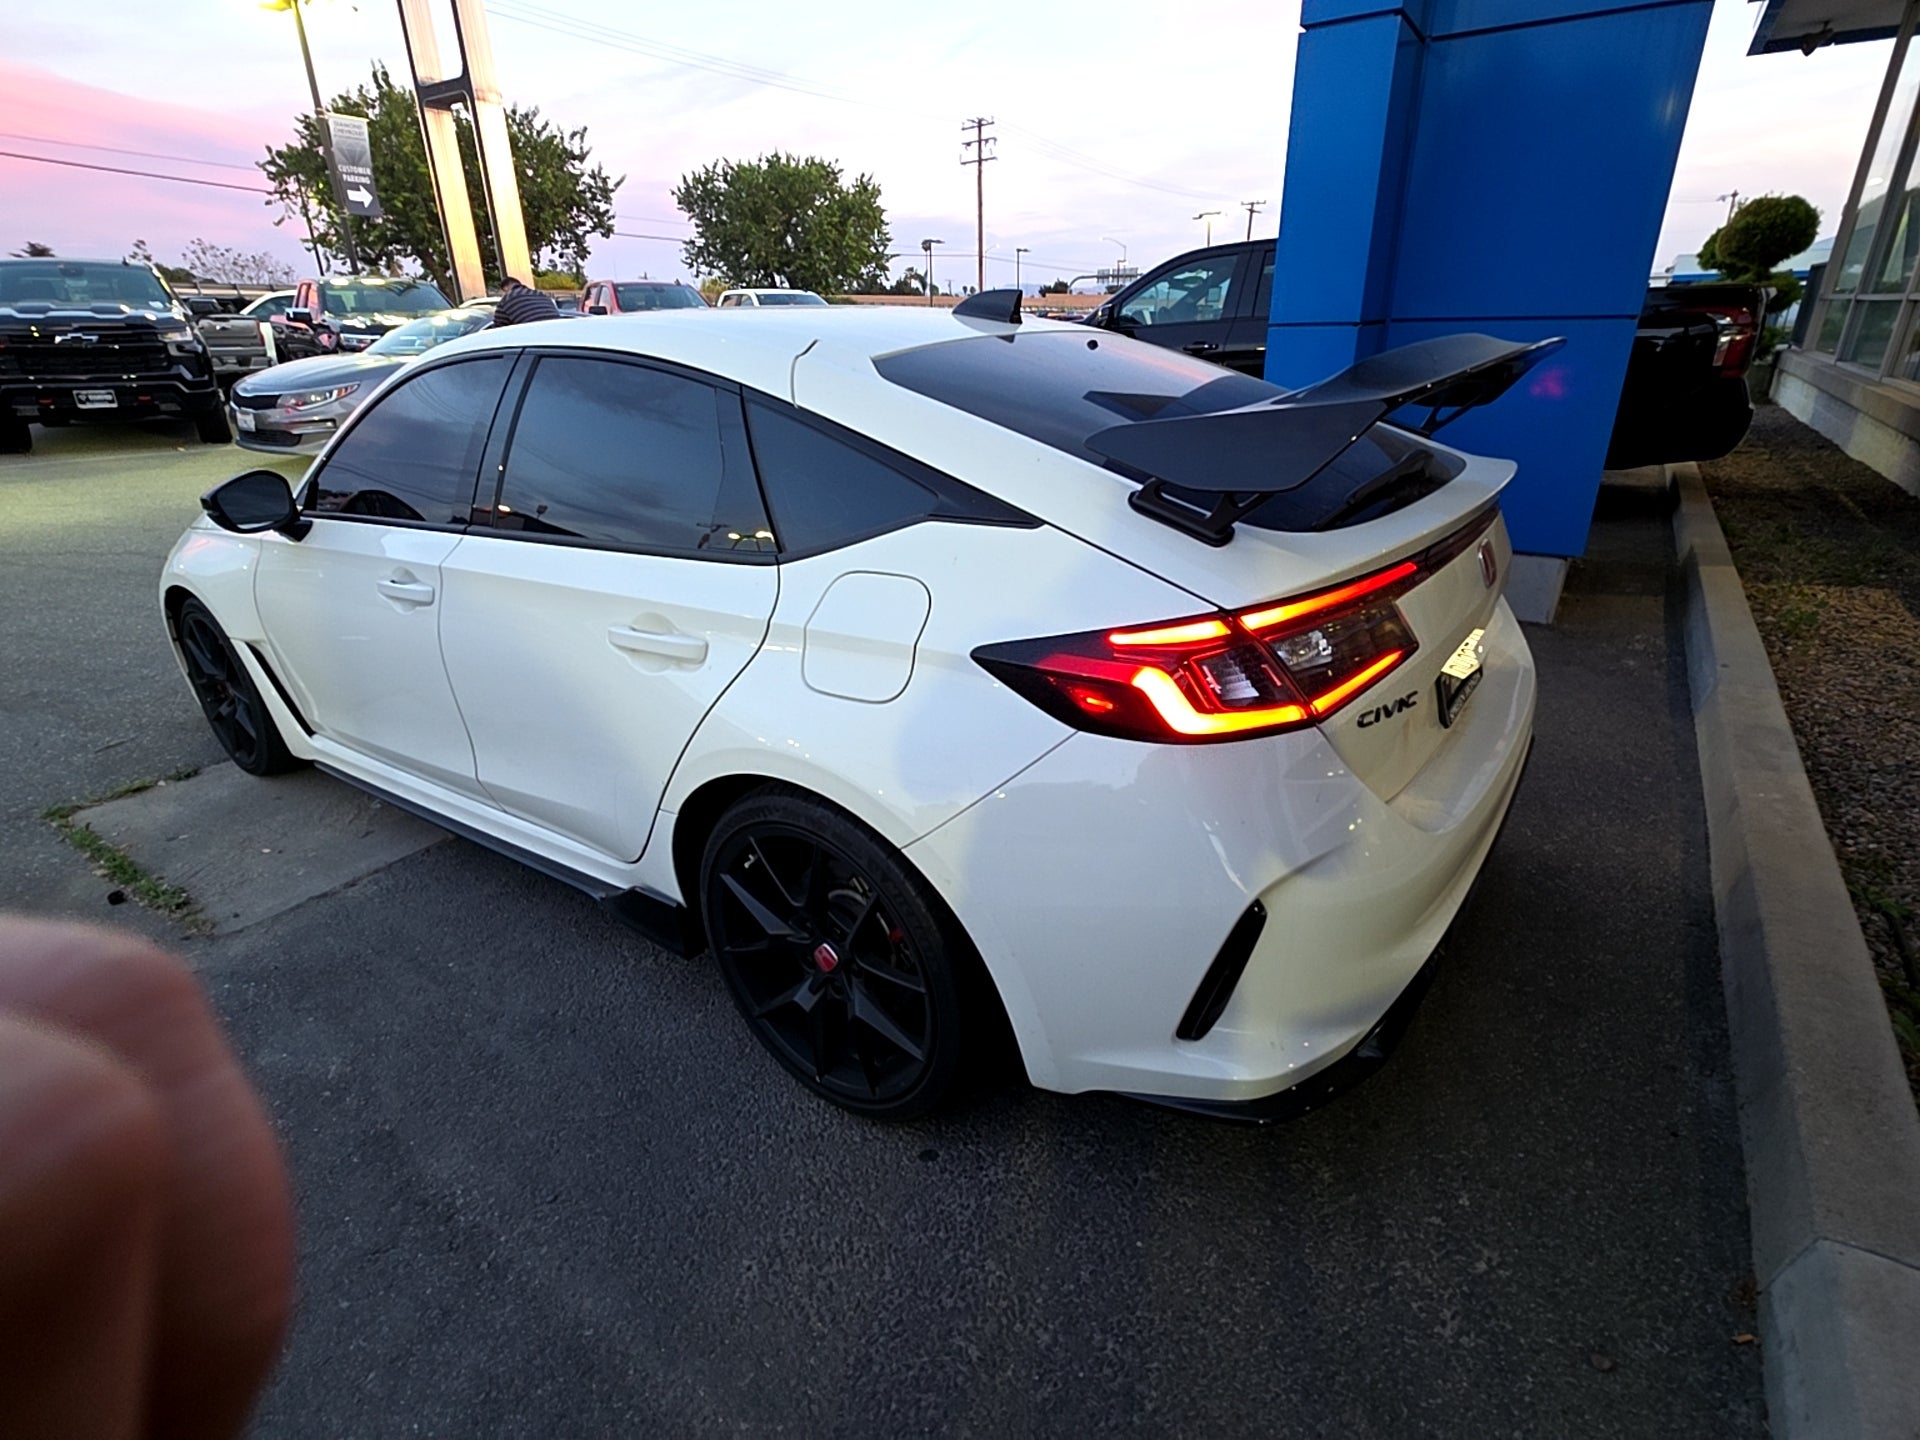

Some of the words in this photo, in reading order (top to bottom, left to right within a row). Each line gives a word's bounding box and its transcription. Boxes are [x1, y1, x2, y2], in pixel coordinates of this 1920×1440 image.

[338, 164, 371, 176] CUSTOMER
[342, 173, 371, 185] PARKING
[1357, 690, 1418, 728] CIVIC
